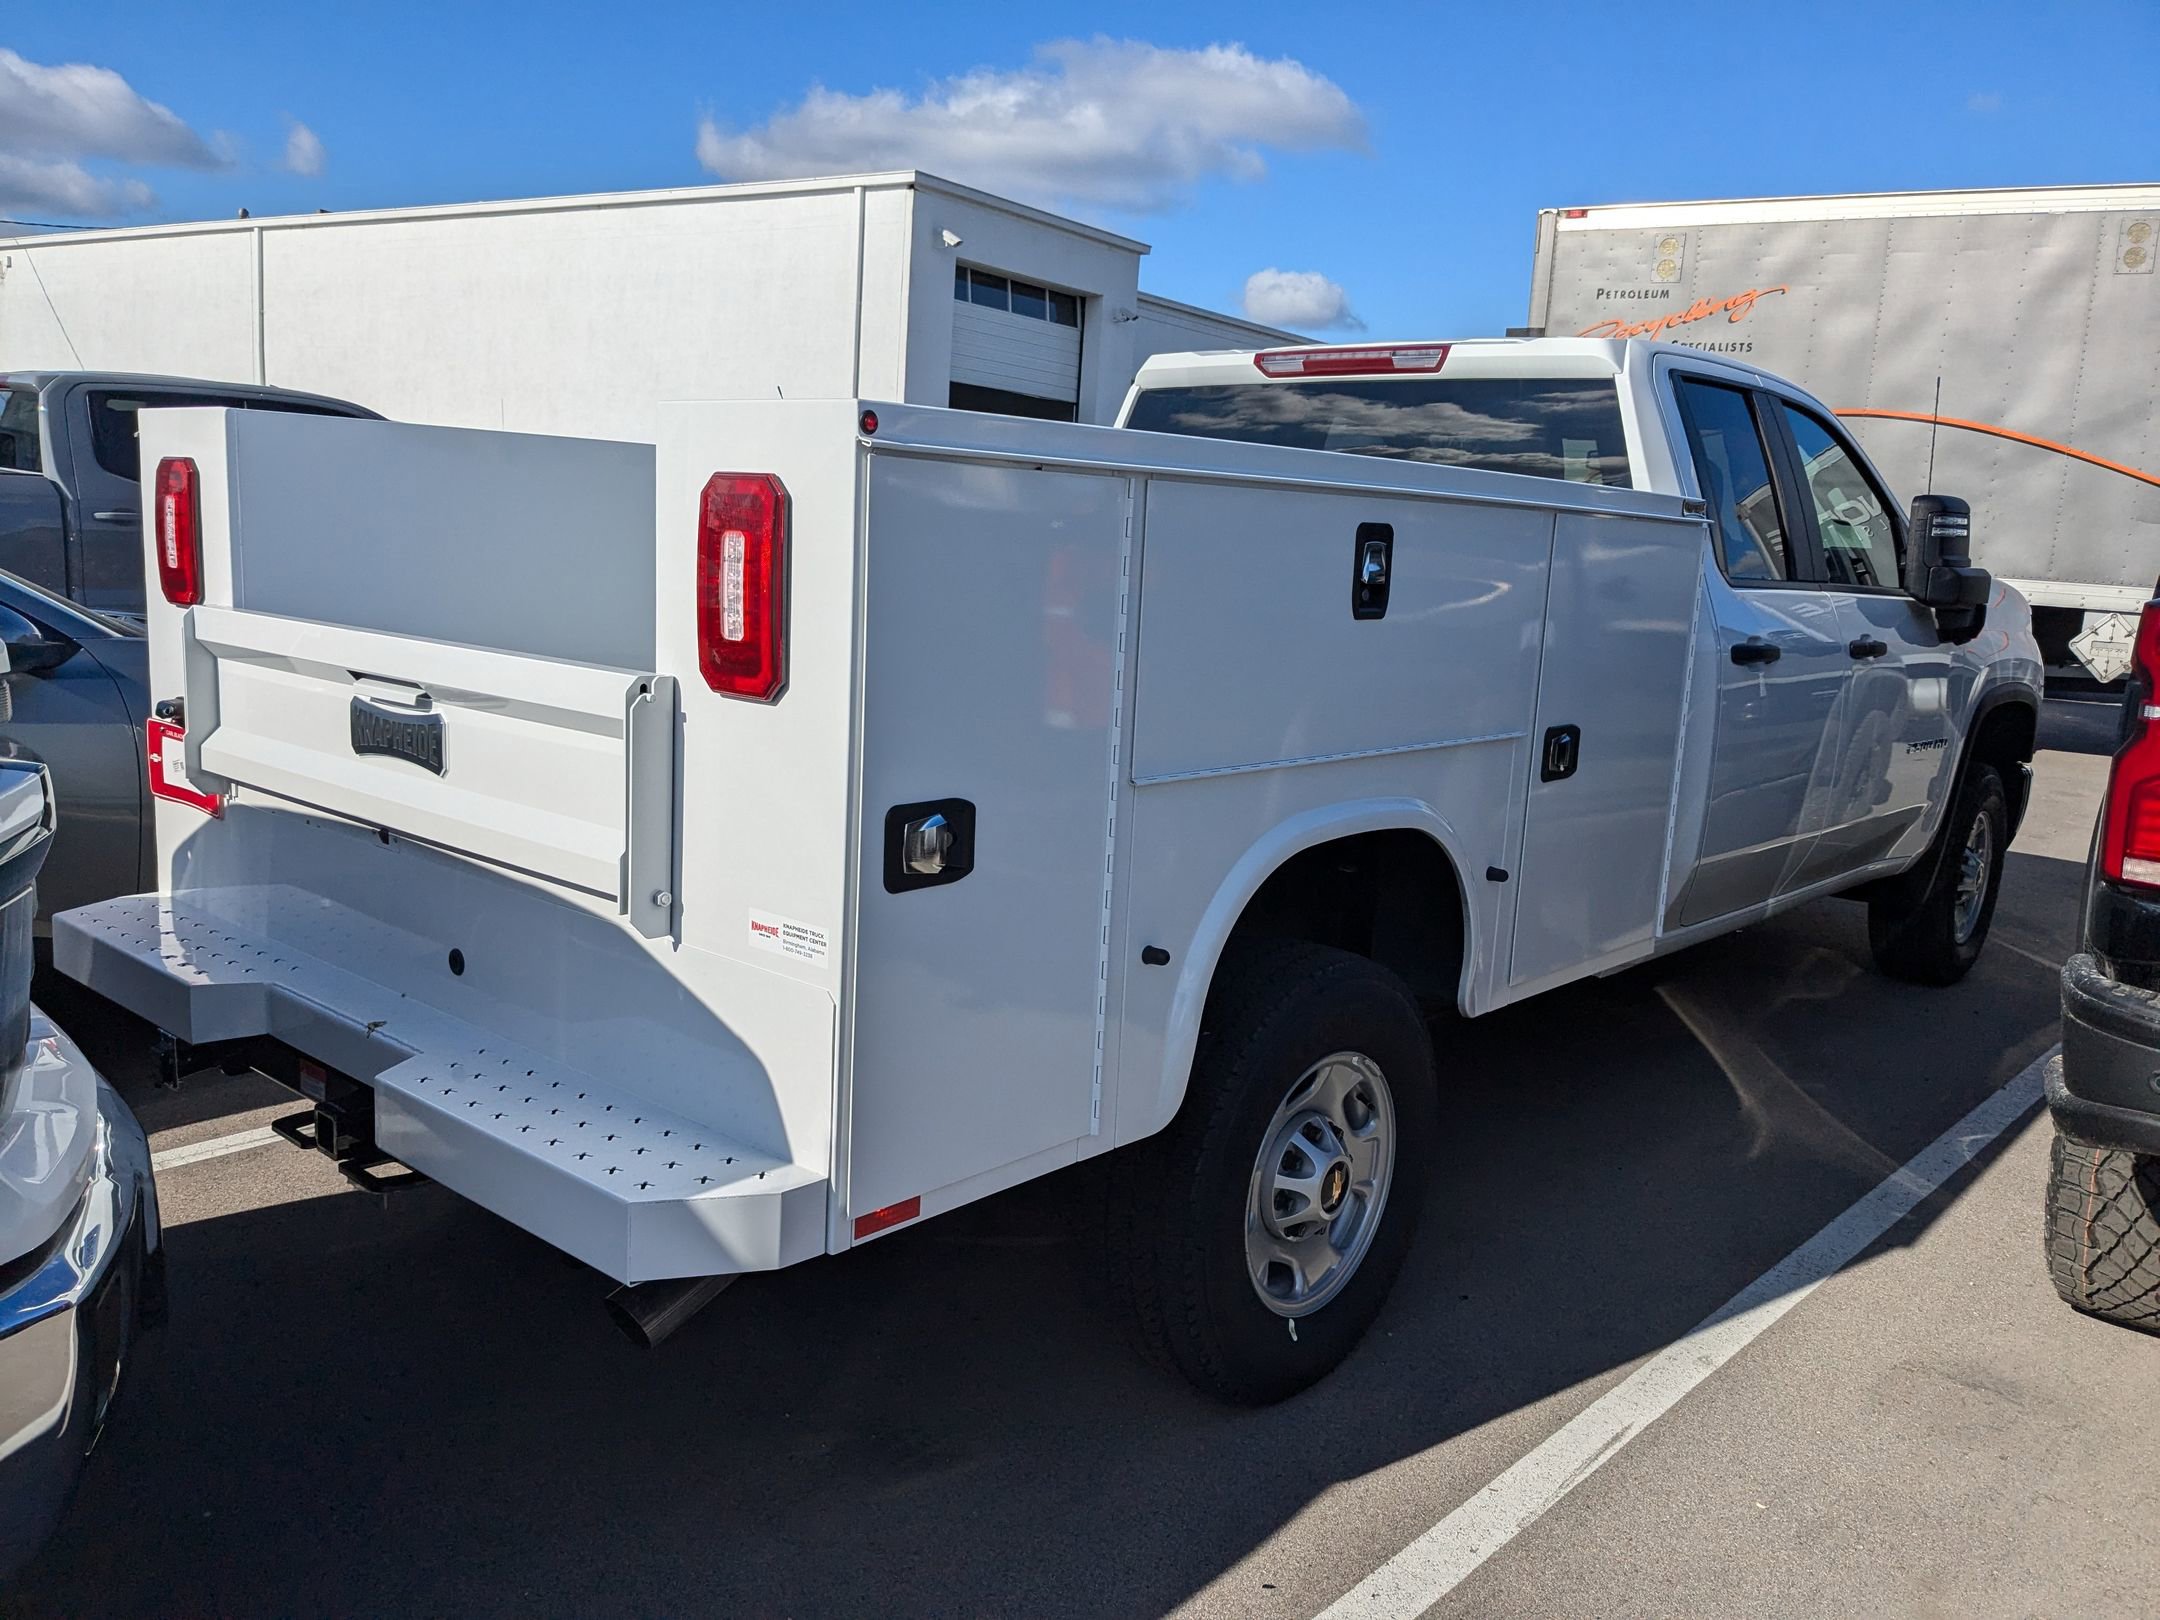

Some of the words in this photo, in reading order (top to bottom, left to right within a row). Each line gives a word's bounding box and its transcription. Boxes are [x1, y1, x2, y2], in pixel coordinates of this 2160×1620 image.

[751, 919, 780, 938] KNAPHEIDE
[782, 922, 808, 935] KNAPHEIDE
[809, 930, 825, 940] TRUCK
[782, 929, 808, 942] EQUIPMENT
[809, 937, 827, 948] CENTER
